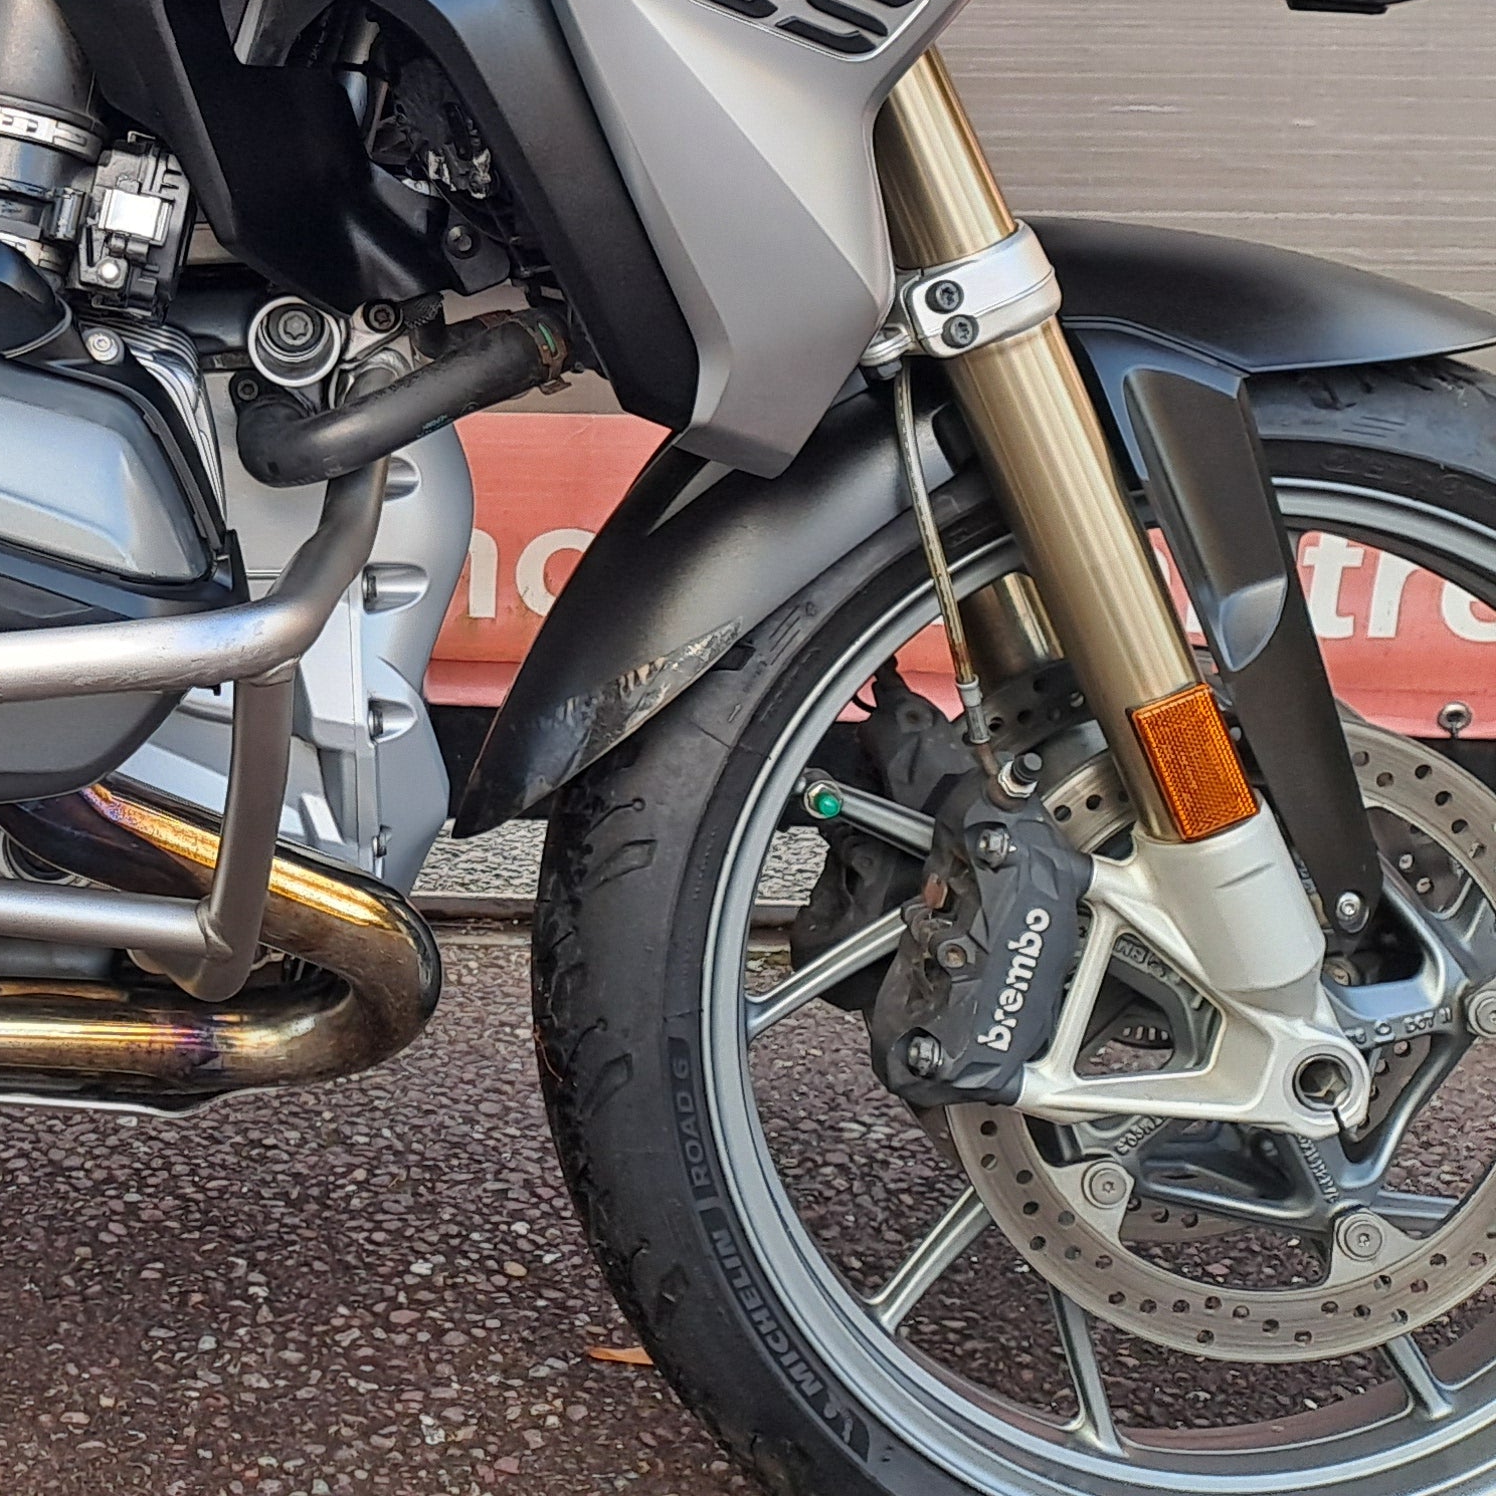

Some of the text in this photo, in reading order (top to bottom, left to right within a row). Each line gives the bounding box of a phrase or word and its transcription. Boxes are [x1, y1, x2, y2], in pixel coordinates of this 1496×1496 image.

[976, 907, 1051, 1053] brembo
[676, 1090, 712, 1187] ROAD
[712, 1228, 825, 1399] MICHELIN
